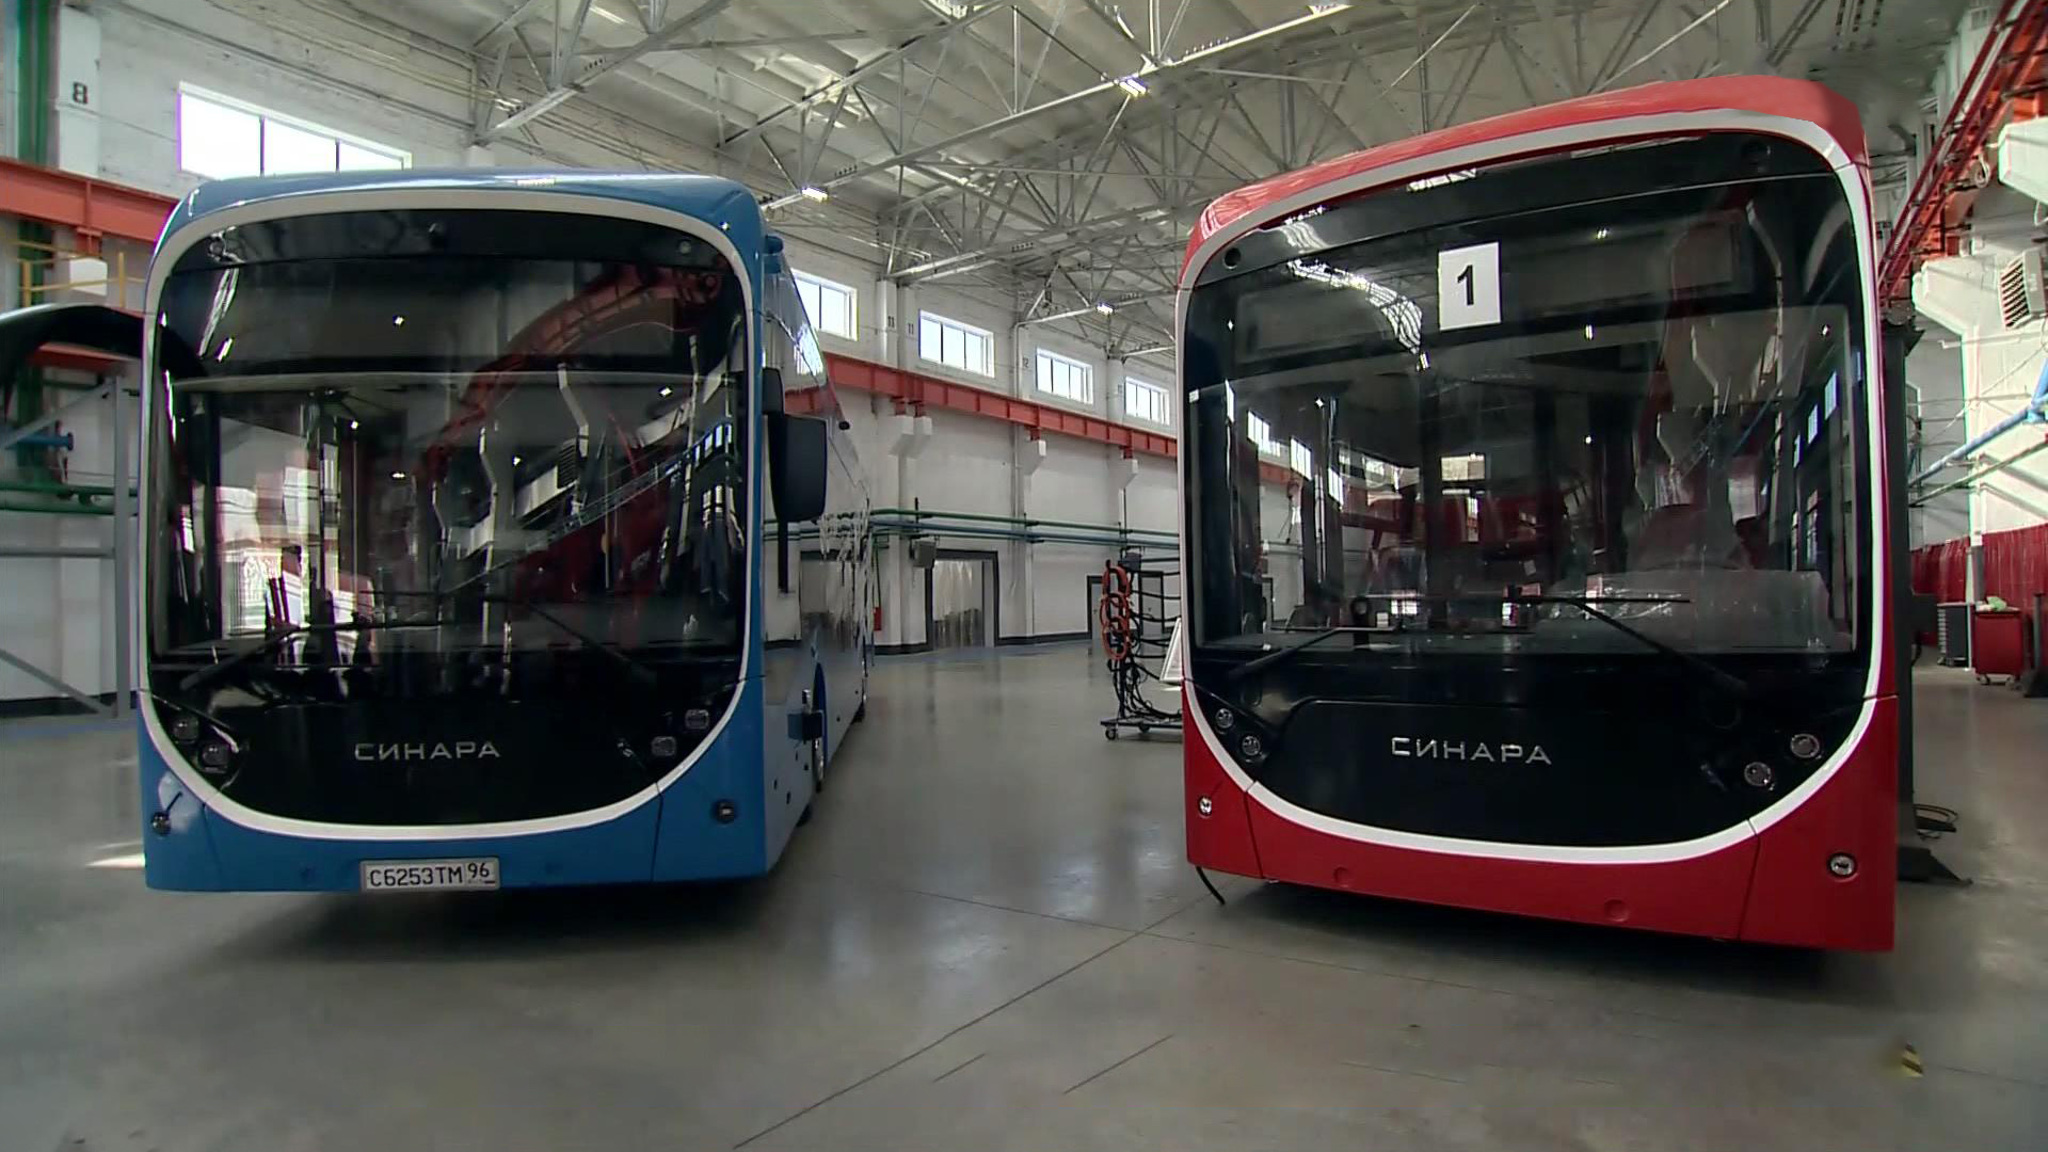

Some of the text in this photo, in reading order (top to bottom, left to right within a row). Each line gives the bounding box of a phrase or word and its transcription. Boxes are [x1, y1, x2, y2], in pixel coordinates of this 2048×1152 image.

[73, 81, 88, 104] 8
[1457, 264, 1474, 306] 1
[355, 741, 500, 760] СИНАРА
[1391, 736, 1552, 765] СИНАРА
[467, 862, 490, 878] 96
